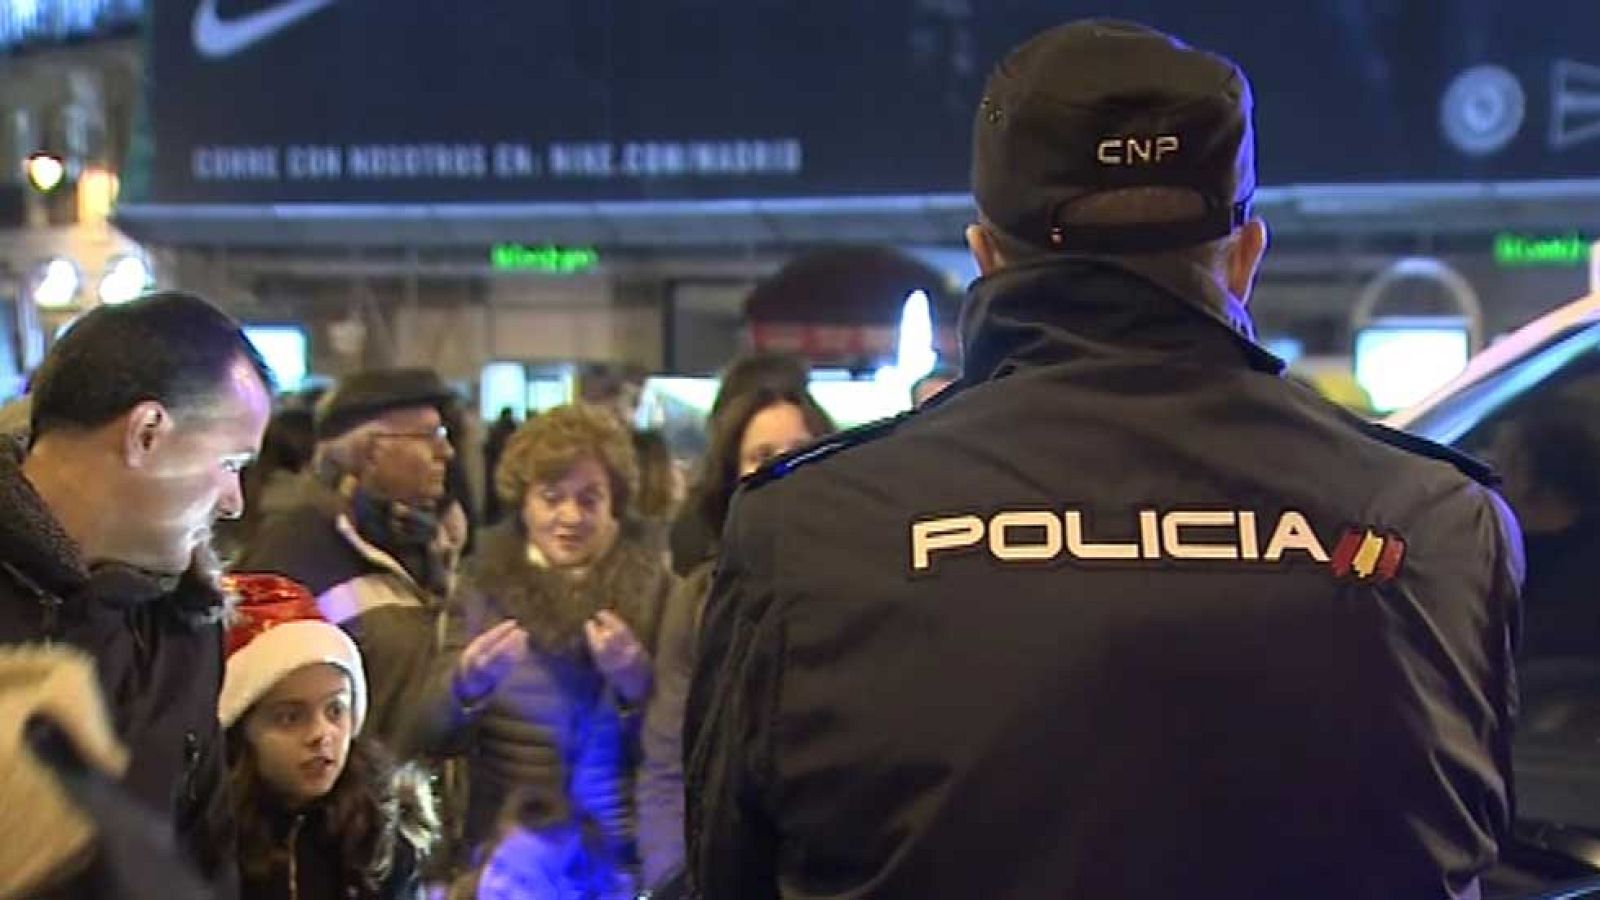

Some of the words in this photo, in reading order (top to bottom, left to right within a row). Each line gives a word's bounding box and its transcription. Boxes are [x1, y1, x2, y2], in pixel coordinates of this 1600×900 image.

[287, 144, 342, 179] CON
[349, 143, 487, 178] NOSOTROS
[1097, 135, 1180, 165] CNP
[911, 509, 1330, 569] POLICIA
